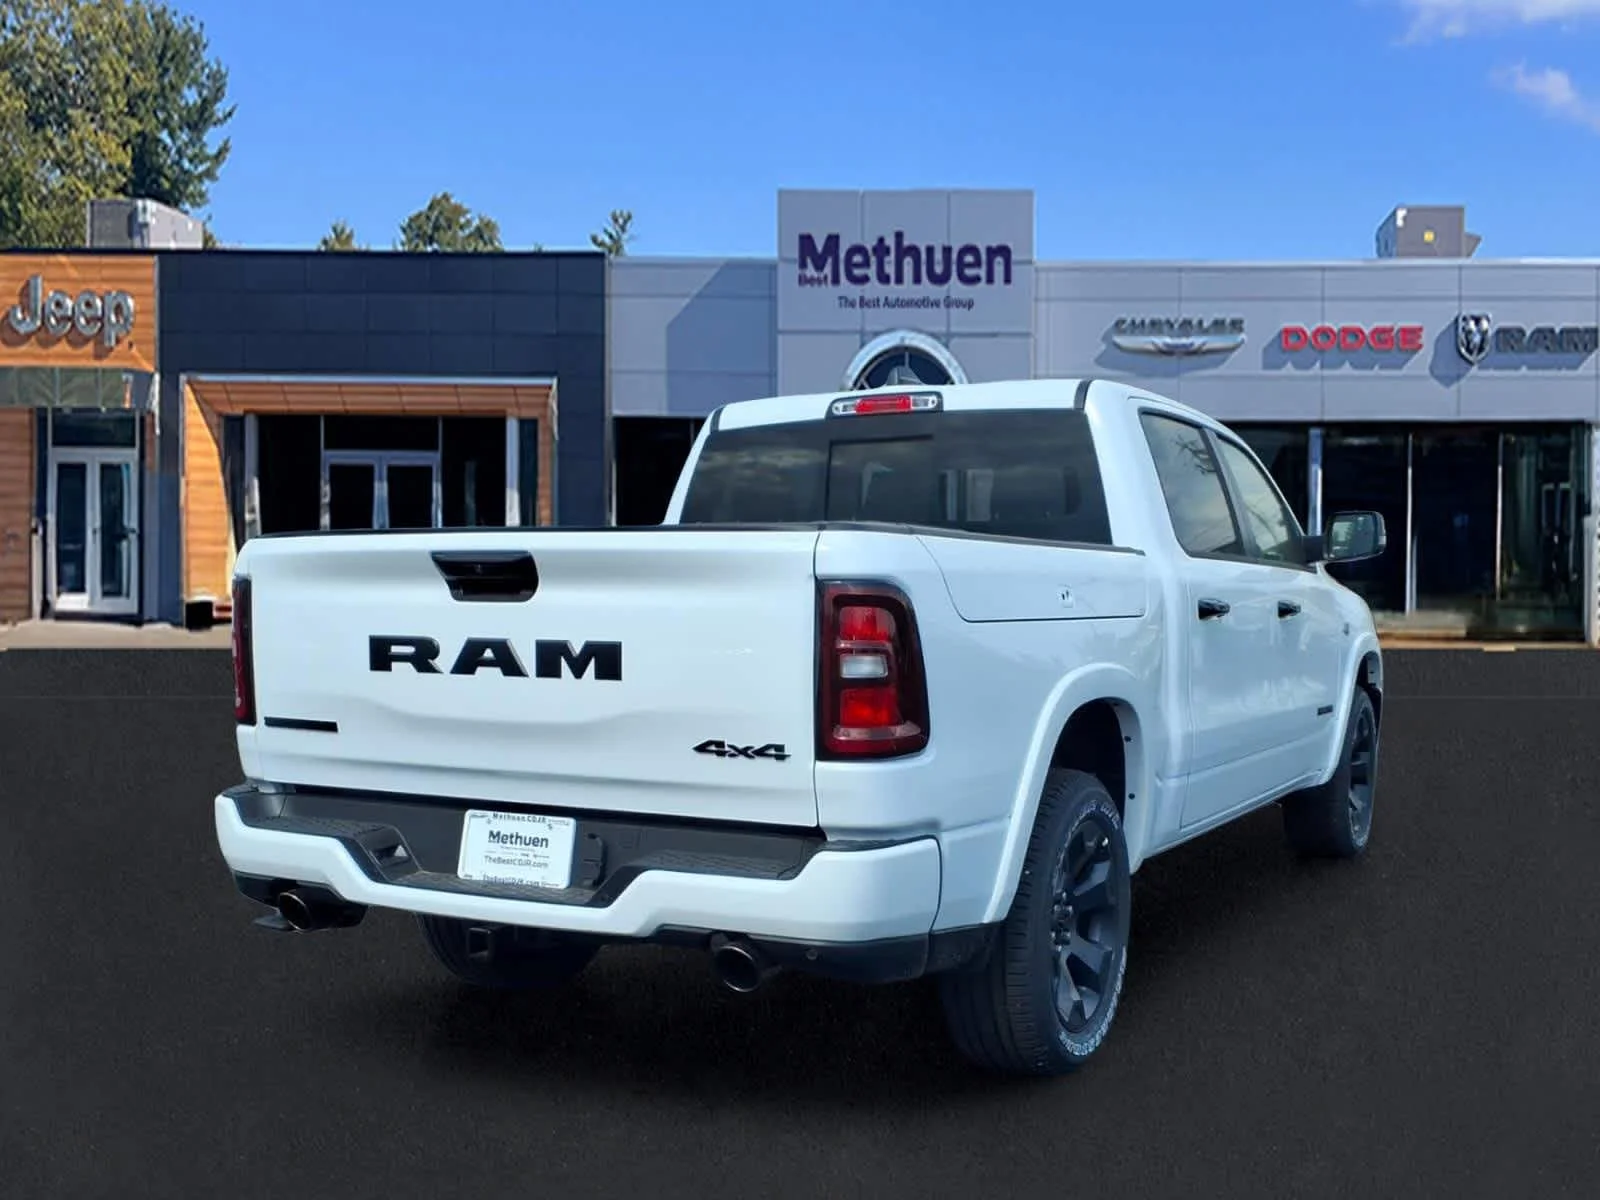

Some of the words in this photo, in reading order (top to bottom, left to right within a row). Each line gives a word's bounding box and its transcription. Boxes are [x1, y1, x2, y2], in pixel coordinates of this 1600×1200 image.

[798, 231, 1012, 286] Methuen
[9, 274, 135, 348] Jeep
[838, 296, 856, 308] The
[858, 296, 881, 308] Best
[883, 296, 941, 308] Automotive
[943, 296, 975, 311] Group
[1280, 325, 1424, 352] DODGE
[1495, 326, 1599, 353] RAM
[368, 634, 623, 681] RAM
[692, 740, 792, 762] 4x4
[488, 830, 549, 848] Methuen
